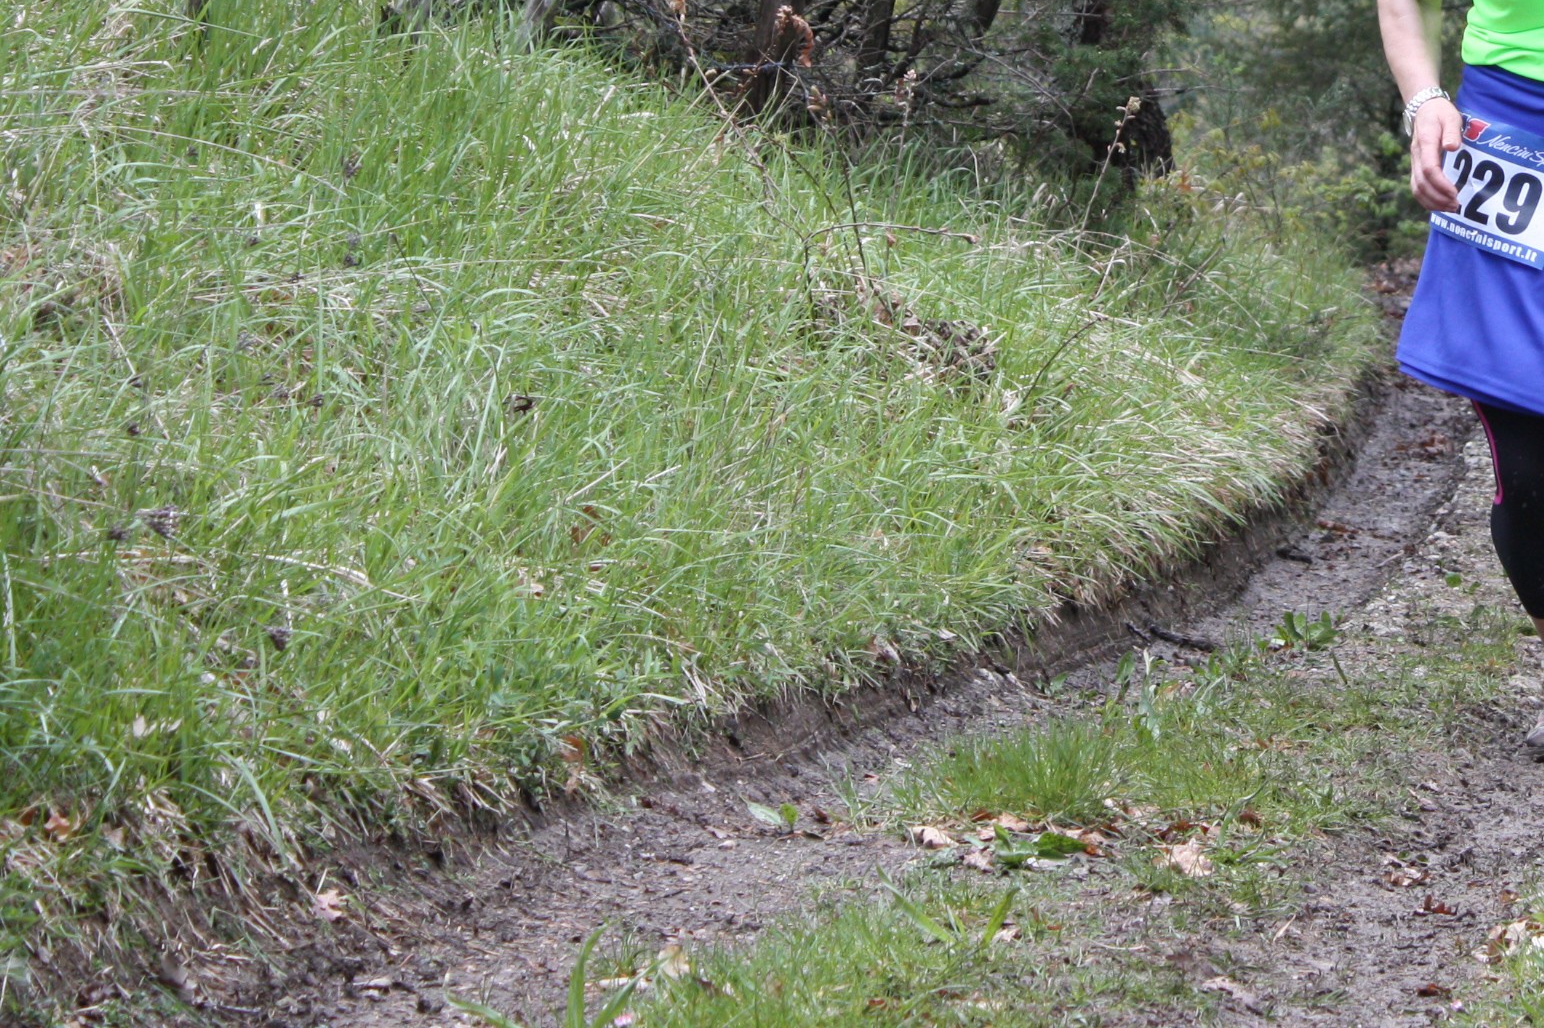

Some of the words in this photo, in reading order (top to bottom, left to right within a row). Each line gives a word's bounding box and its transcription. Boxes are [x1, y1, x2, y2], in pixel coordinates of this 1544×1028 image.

[1476, 134, 1531, 160] Nencini
[1447, 148, 1543, 236] 229
[1430, 213, 1538, 263] www.nencinisport.it
